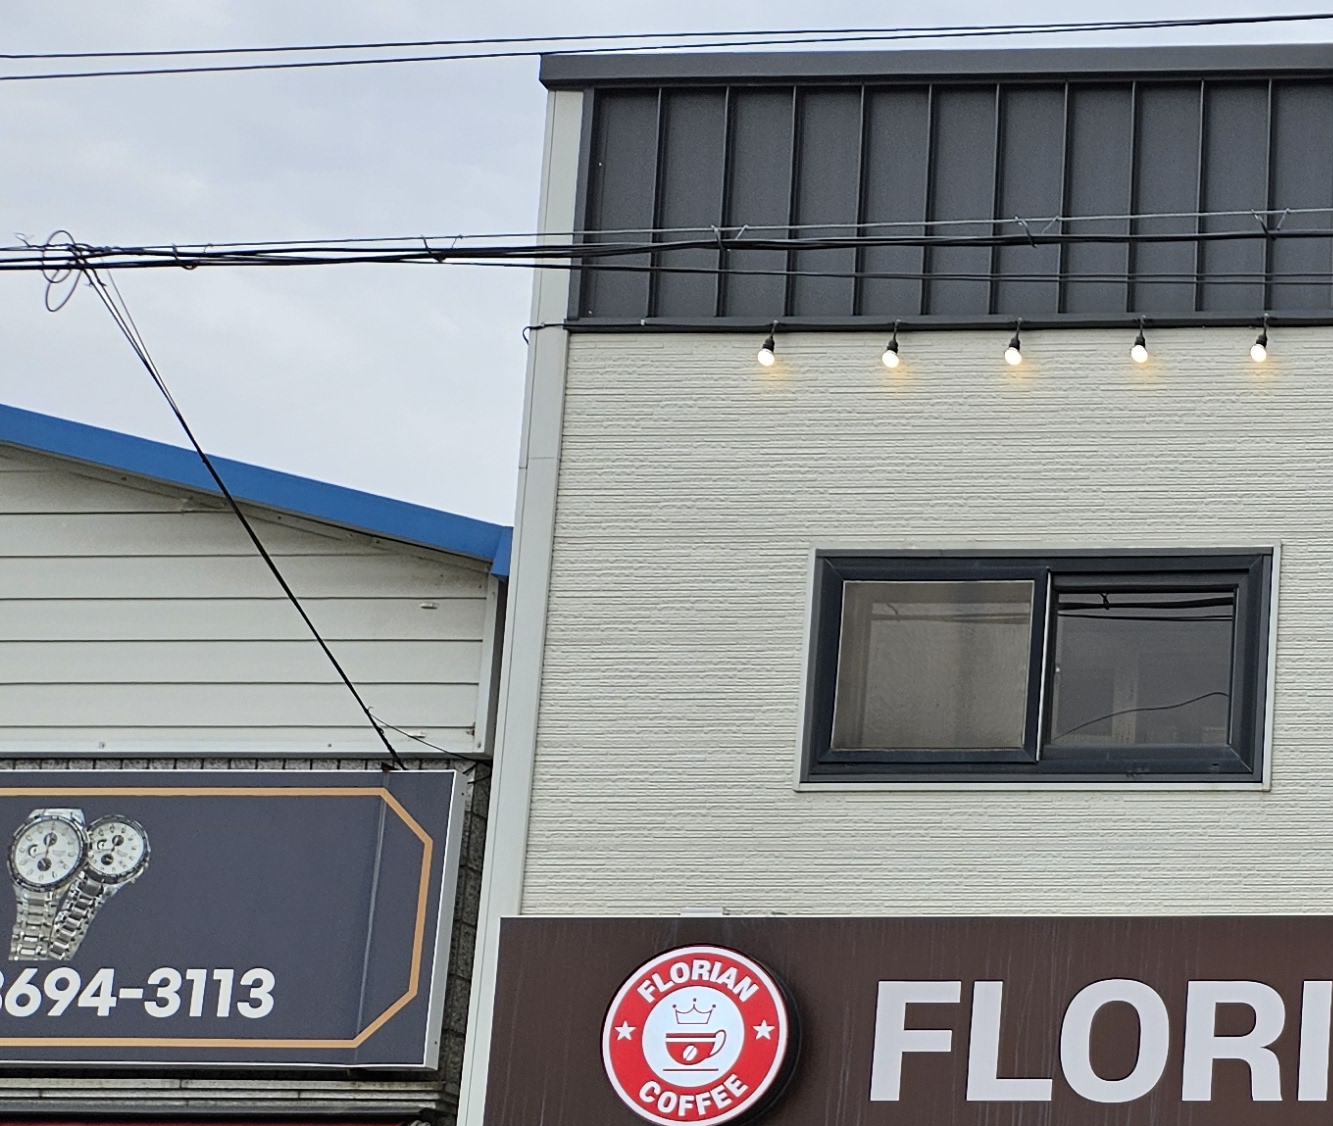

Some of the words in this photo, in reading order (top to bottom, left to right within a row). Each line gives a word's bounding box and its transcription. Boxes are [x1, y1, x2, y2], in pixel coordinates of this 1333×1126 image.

[0, 967, 275, 1019] 694-3113
[637, 959, 759, 1003] FLORIAN
[639, 1074, 748, 1117] COFFEE
